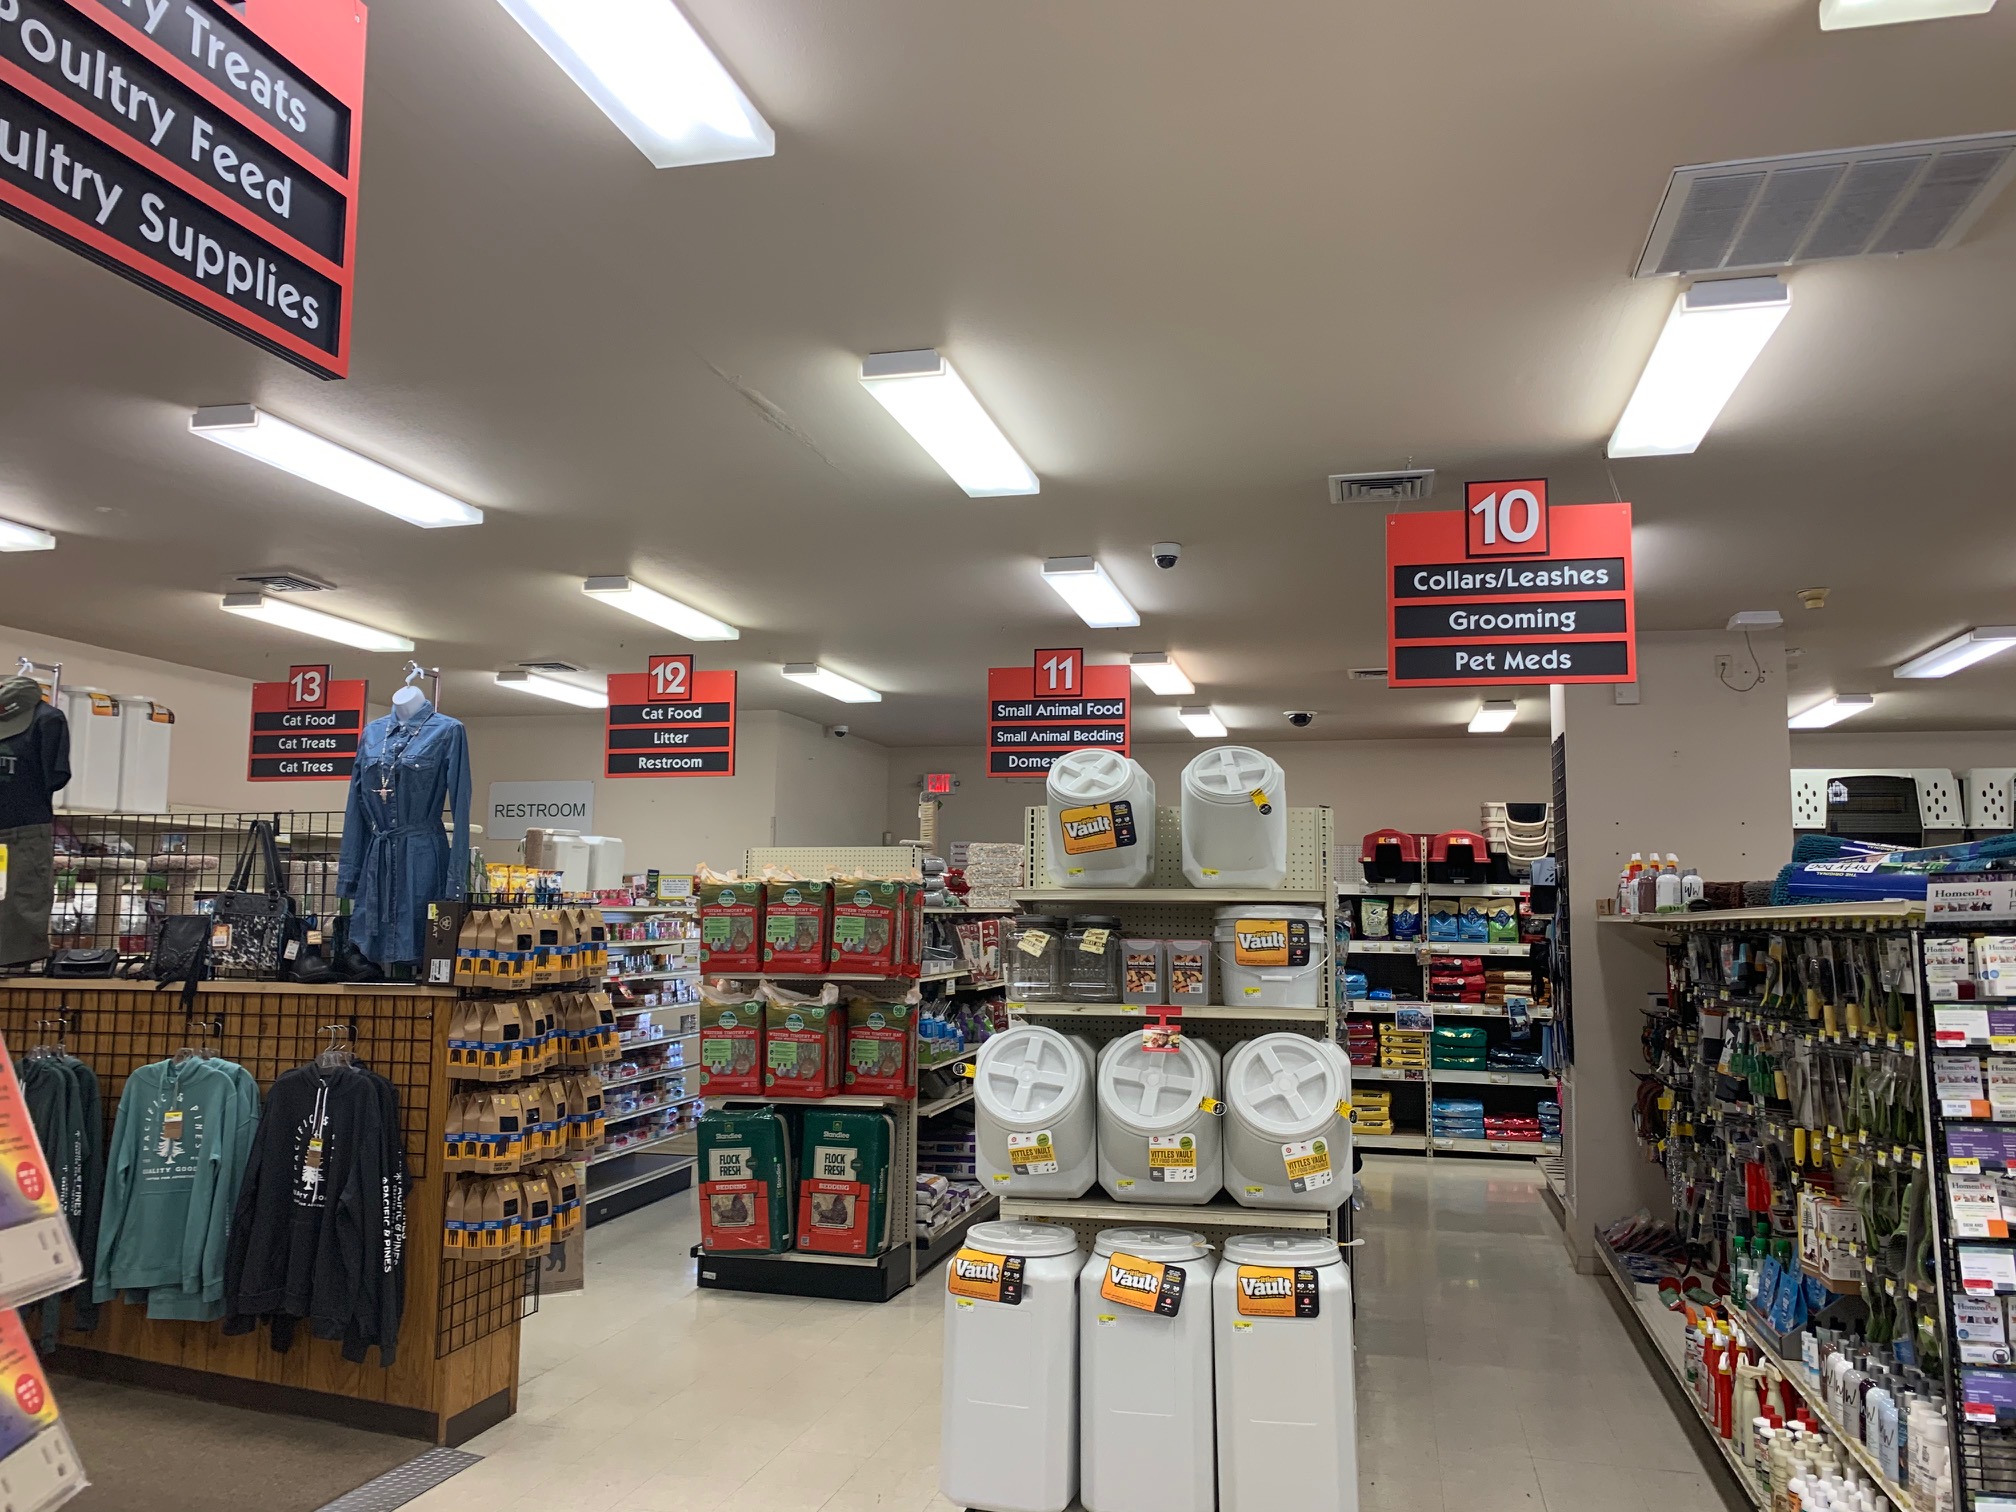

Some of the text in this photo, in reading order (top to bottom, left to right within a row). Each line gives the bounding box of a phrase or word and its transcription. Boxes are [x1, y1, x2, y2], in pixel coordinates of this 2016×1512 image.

[185, 6, 307, 132] Treats
[191, 116, 291, 218] Feed
[138, 192, 319, 329] Supplies
[1472, 489, 1540, 544] 10
[1413, 566, 1609, 591] Collars/Leashes
[1449, 608, 1576, 632] Grooming
[1455, 650, 1572, 671] Pet Meds
[651, 661, 686, 694] 12
[1042, 656, 1073, 689] 11
[291, 671, 321, 702] 13
[642, 707, 702, 719] Cat Food
[997, 702, 1123, 717] Small Animal Food
[282, 714, 336, 726] Cat Food
[278, 737, 336, 749] Cat Treats
[654, 732, 689, 744] Litter
[997, 730, 1124, 743] Small Animal Bedding
[279, 761, 334, 773] Cat Trees
[638, 757, 702, 769] Restroom
[928, 774, 951, 792] EXIT
[494, 803, 586, 818] RESTROOM
[1064, 816, 1111, 838] Vault
[1935, 889, 1992, 897] HomeoPet
[1238, 932, 1285, 949] Vault
[719, 1155, 740, 1165] FLOCK
[825, 1153, 845, 1164] FLOCK
[1287, 1158, 1311, 1170] VITTLES
[720, 1166, 741, 1176] FRESH
[824, 1165, 846, 1176] FRESH
[384, 1238, 392, 1273] PINES
[957, 1259, 999, 1282] Vault
[1111, 1266, 1158, 1293] Vault
[1240, 1278, 1292, 1296] Vault
